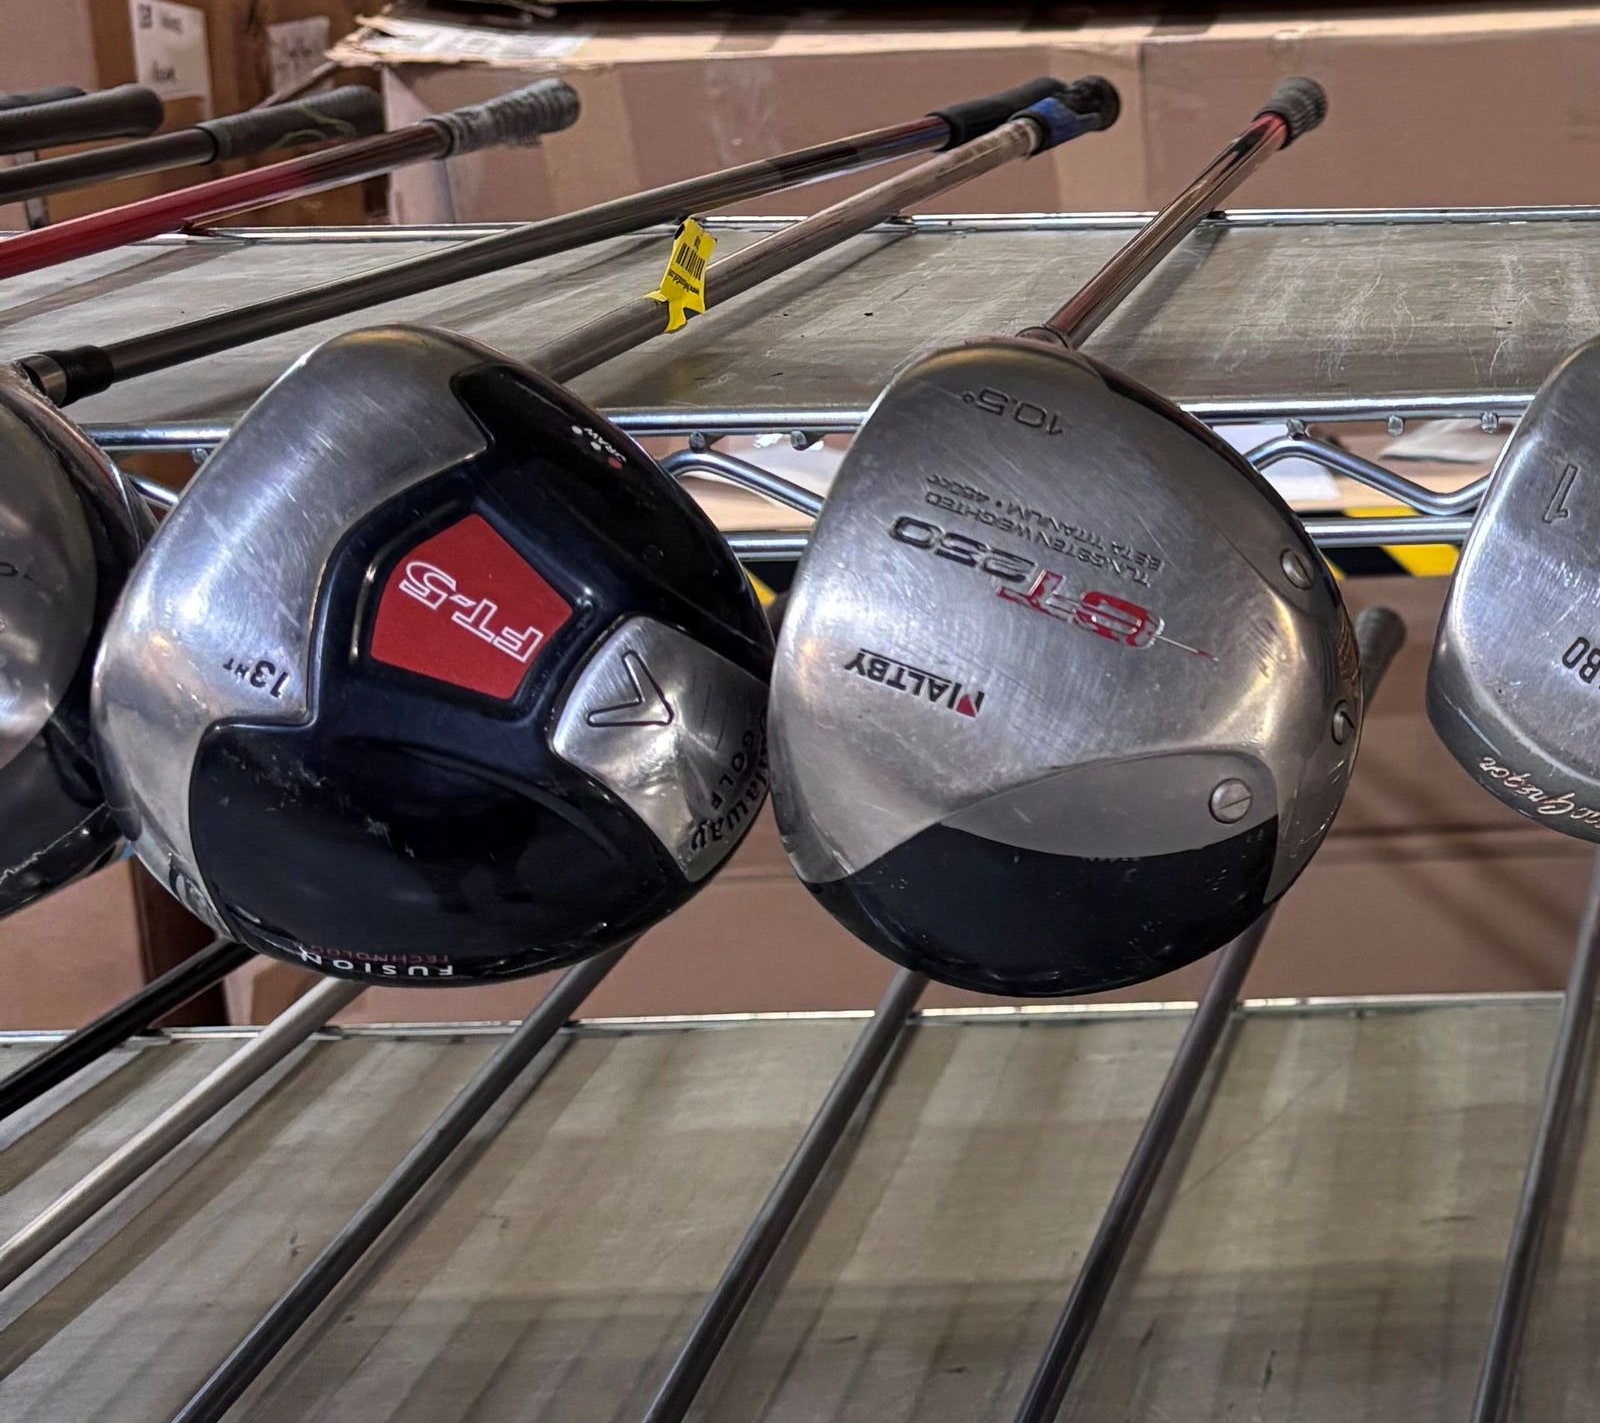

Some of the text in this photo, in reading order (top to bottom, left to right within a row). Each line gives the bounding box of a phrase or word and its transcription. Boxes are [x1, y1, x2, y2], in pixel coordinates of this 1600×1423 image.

[961, 386, 1063, 436] 10.5°
[923, 490, 1151, 588] TUNGSTEN WEIGHTED
[1005, 501, 1103, 550] TITANIUM
[1110, 542, 1163, 572] BETA
[399, 559, 544, 665] FT-5
[843, 647, 987, 718] MALTBY
[709, 730, 755, 810] GOLF
[298, 945, 454, 977] FUSION
